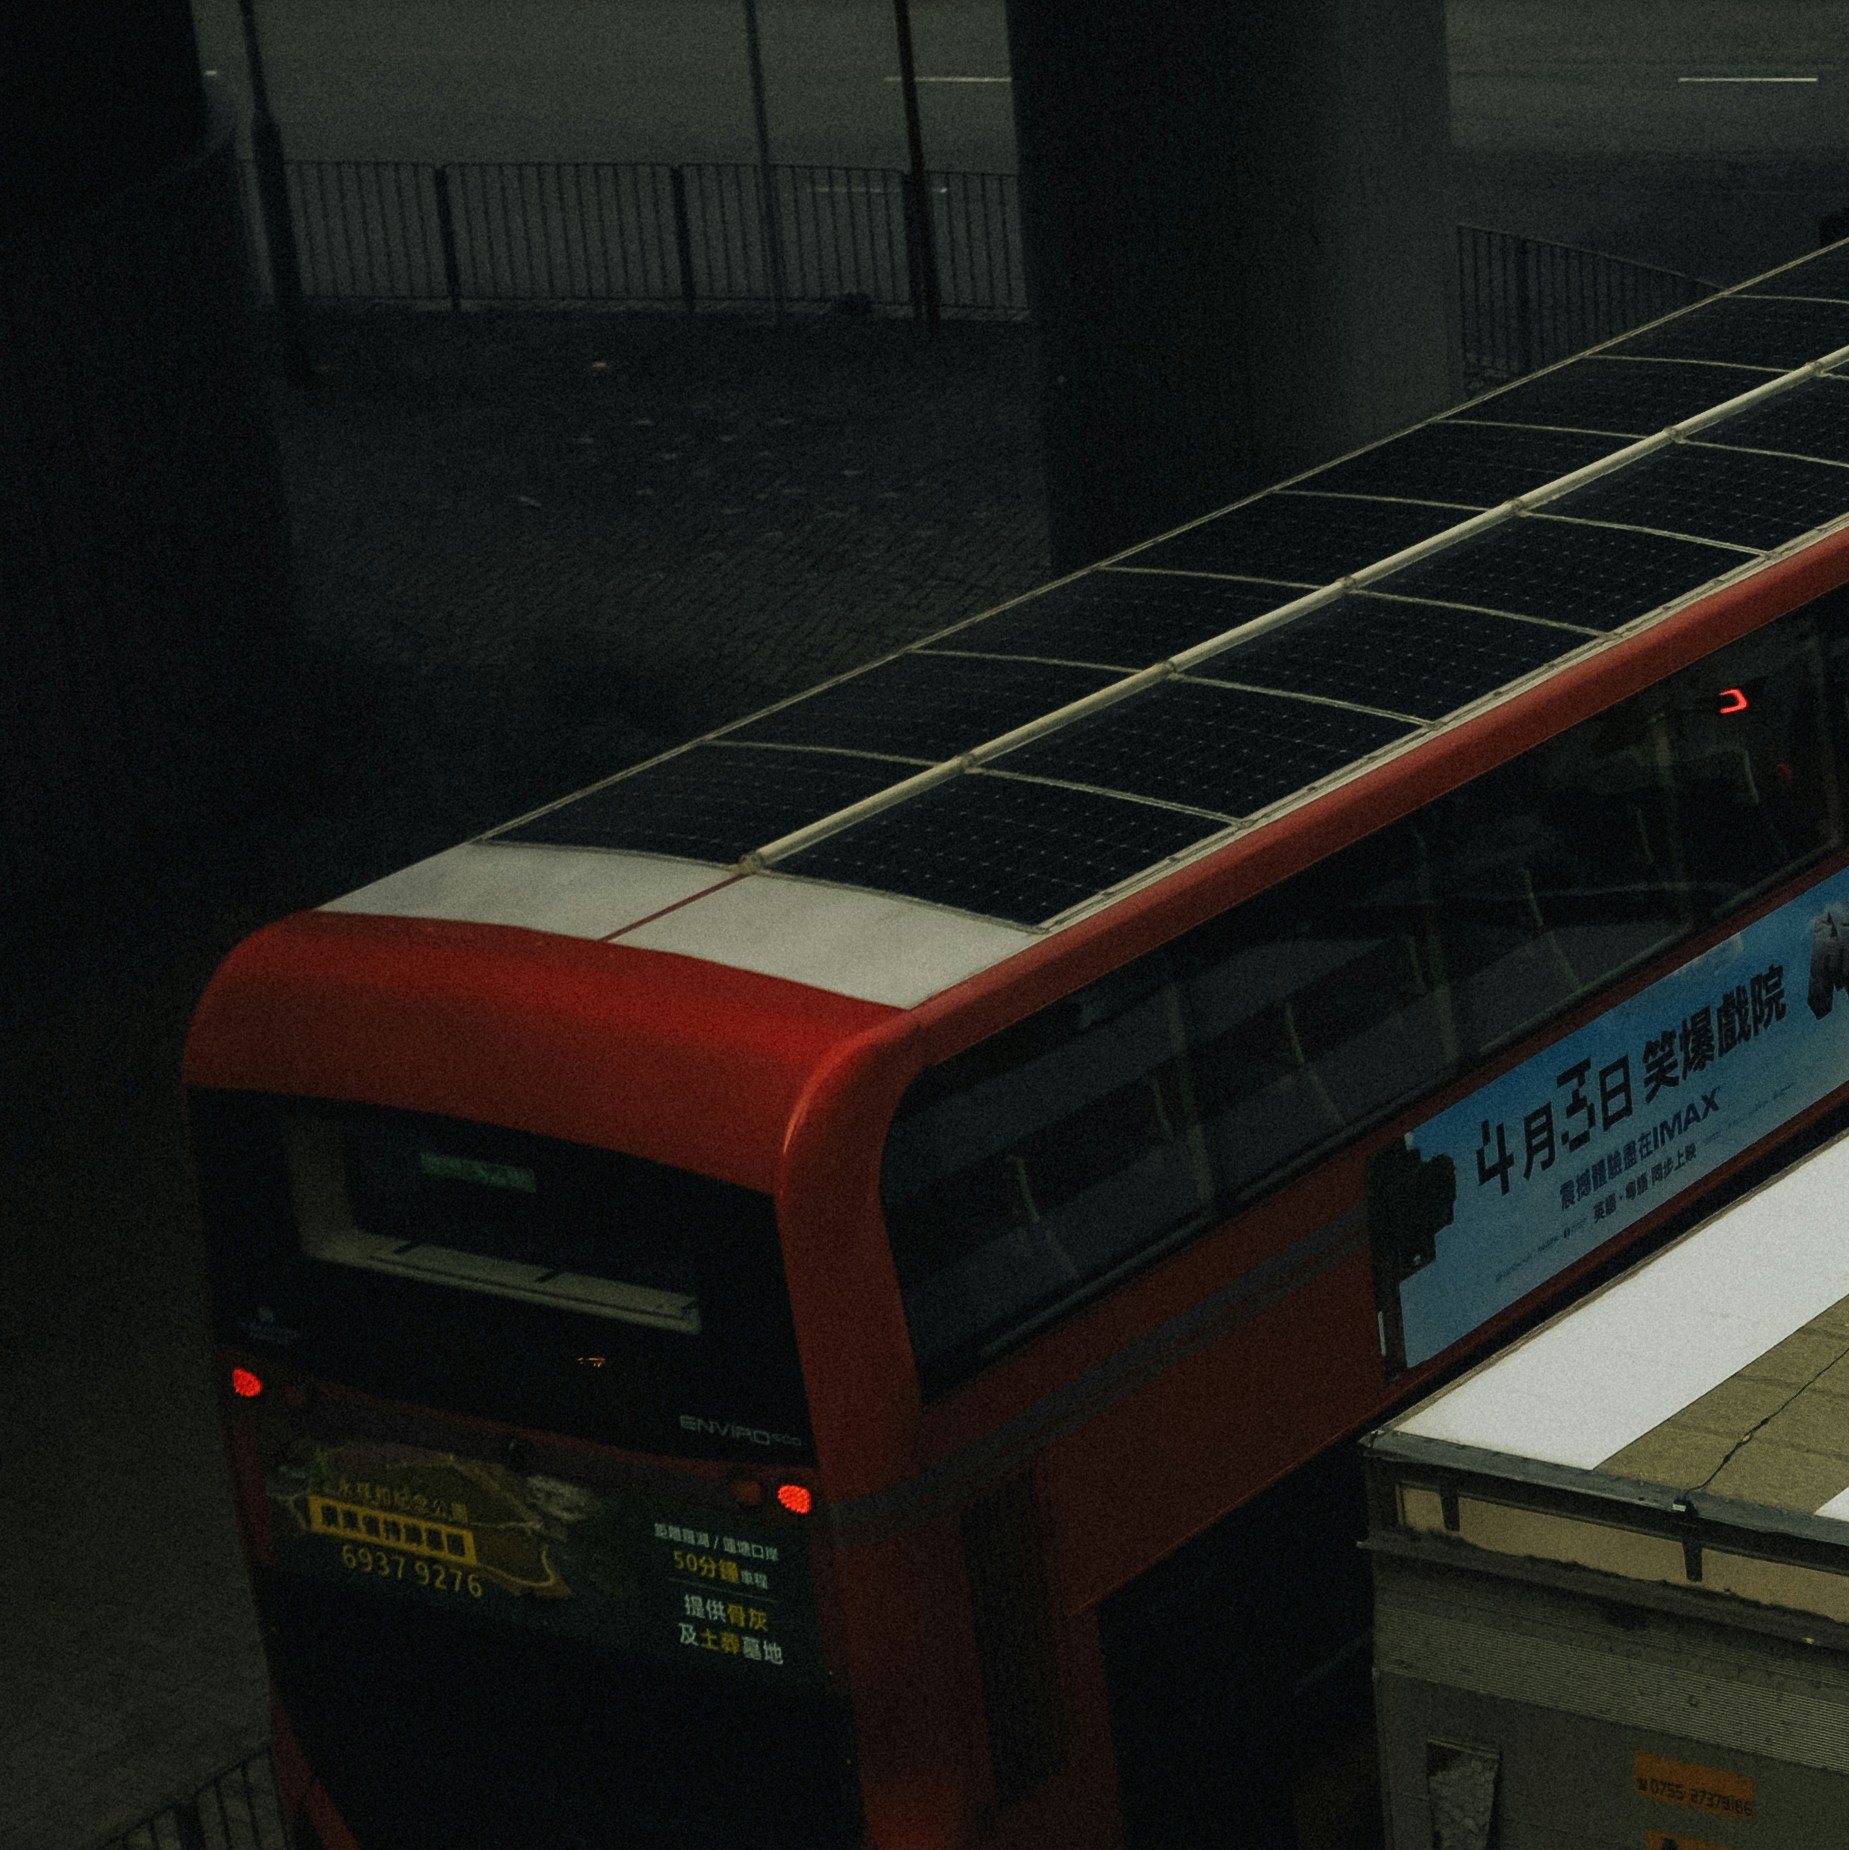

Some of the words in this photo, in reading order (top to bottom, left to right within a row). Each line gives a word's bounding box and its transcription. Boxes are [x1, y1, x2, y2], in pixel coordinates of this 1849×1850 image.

[1476, 1055, 1633, 1196] 4月3日
[1642, 963, 1787, 1104] 笑爆戲院
[341, 1543, 406, 1580] 6937
[413, 1559, 485, 1600] 9276
[684, 1593, 769, 1633] 提供骨灰
[1649, 1778, 1685, 1802] 0755
